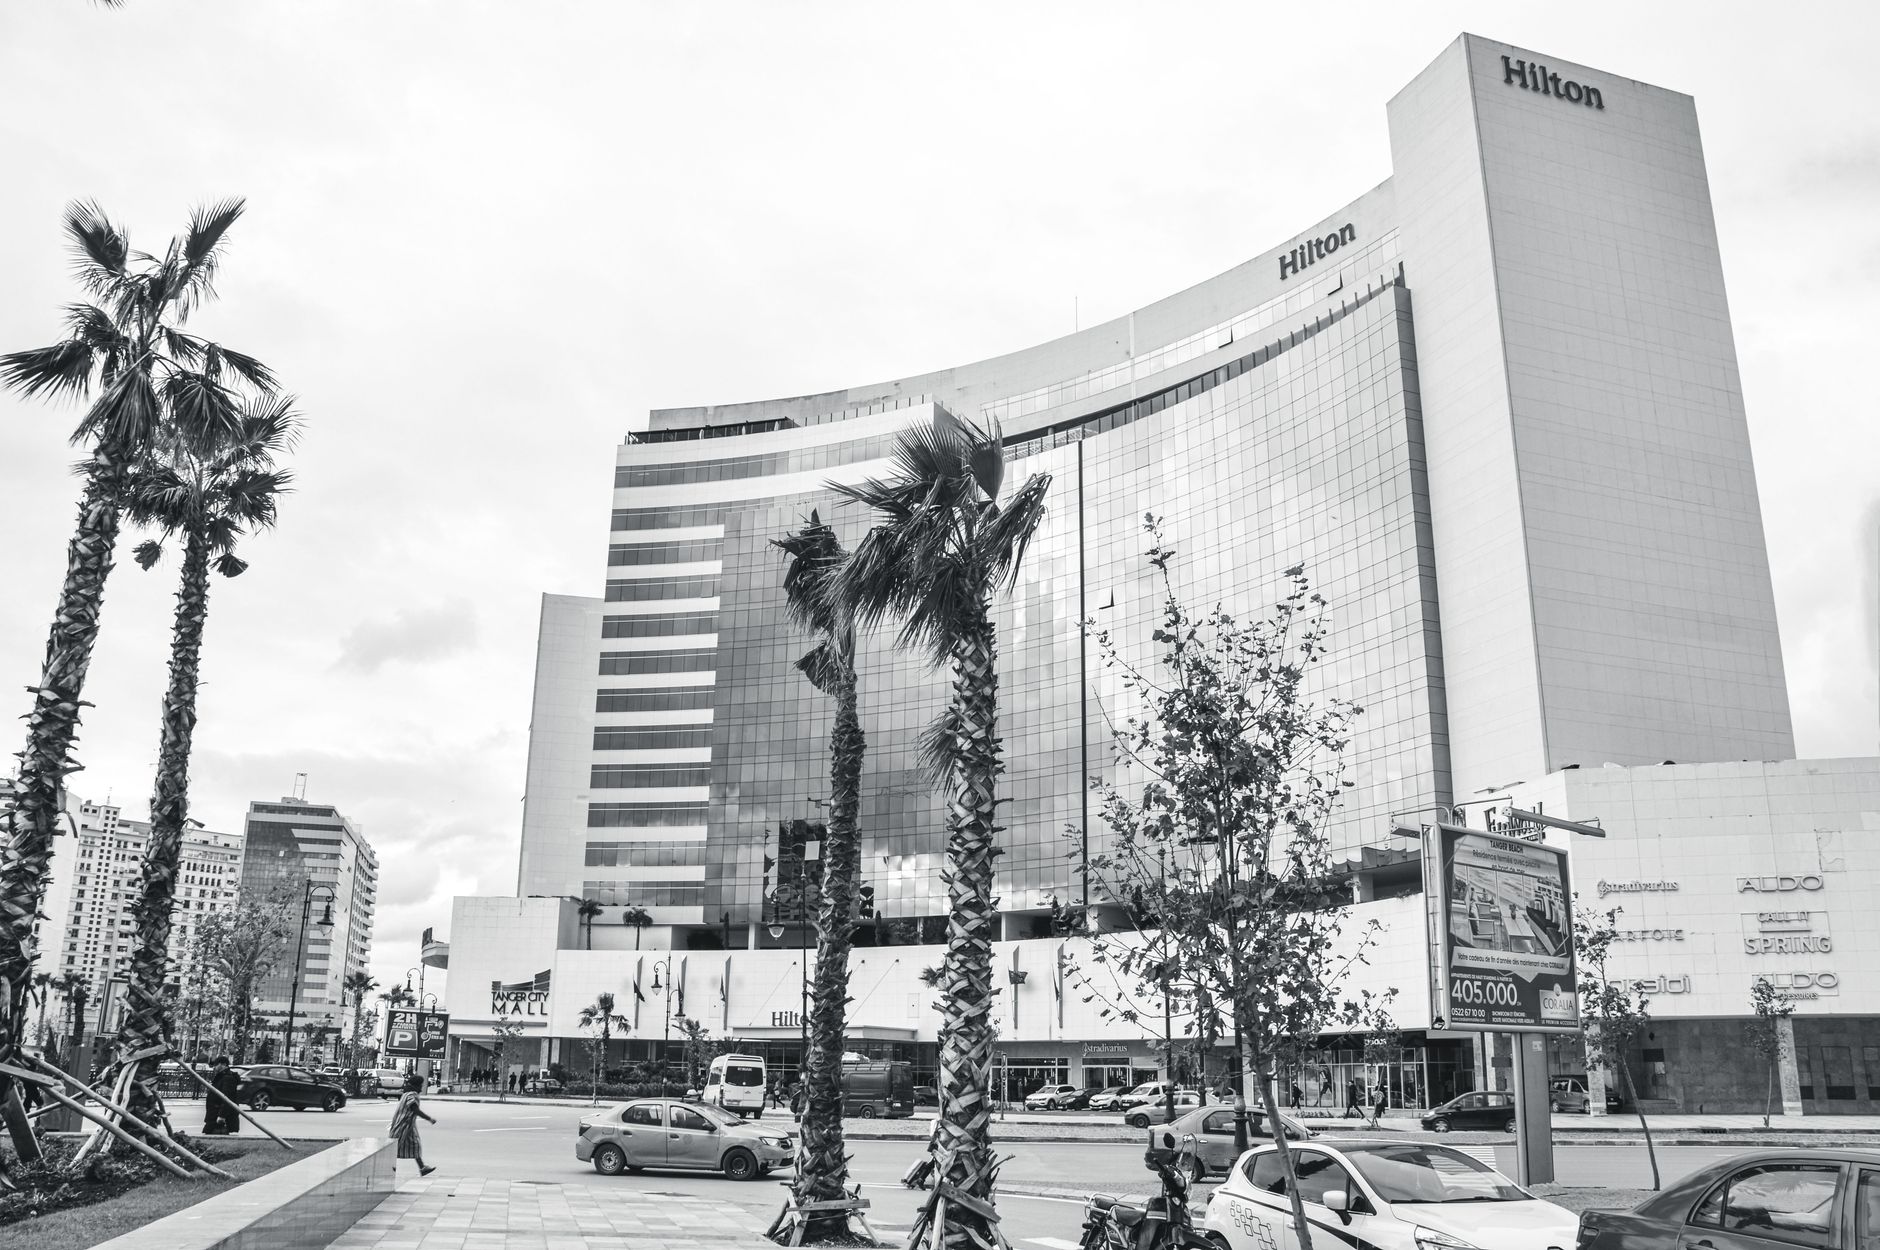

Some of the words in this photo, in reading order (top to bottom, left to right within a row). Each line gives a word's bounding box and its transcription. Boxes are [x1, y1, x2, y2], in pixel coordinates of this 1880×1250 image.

[1501, 55, 1605, 110] Hilton
[1278, 222, 1356, 281] Hilton
[1490, 840, 1508, 851] TANGER
[1508, 843, 1524, 853] BEACH
[1736, 875, 1823, 893] ALDO
[1757, 911, 1791, 922] CALL
[1608, 929, 1685, 942] ARFOIS
[1744, 937, 1832, 954] SPRING
[491, 992, 527, 1002] TANGER
[528, 992, 549, 1002] CITY
[1452, 980, 1518, 1005] 405.000
[491, 1001, 548, 1015] MALL
[1542, 997, 1574, 1010] CORALIA
[394, 1012, 417, 1024] 2H
[771, 1011, 807, 1027] Hilt
[1451, 1007, 1464, 1016] 0522
[1464, 1008, 1471, 1016] 67
[1471, 1008, 1478, 1017] 10
[1478, 1009, 1486, 1017] 00
[393, 1031, 413, 1047] P
